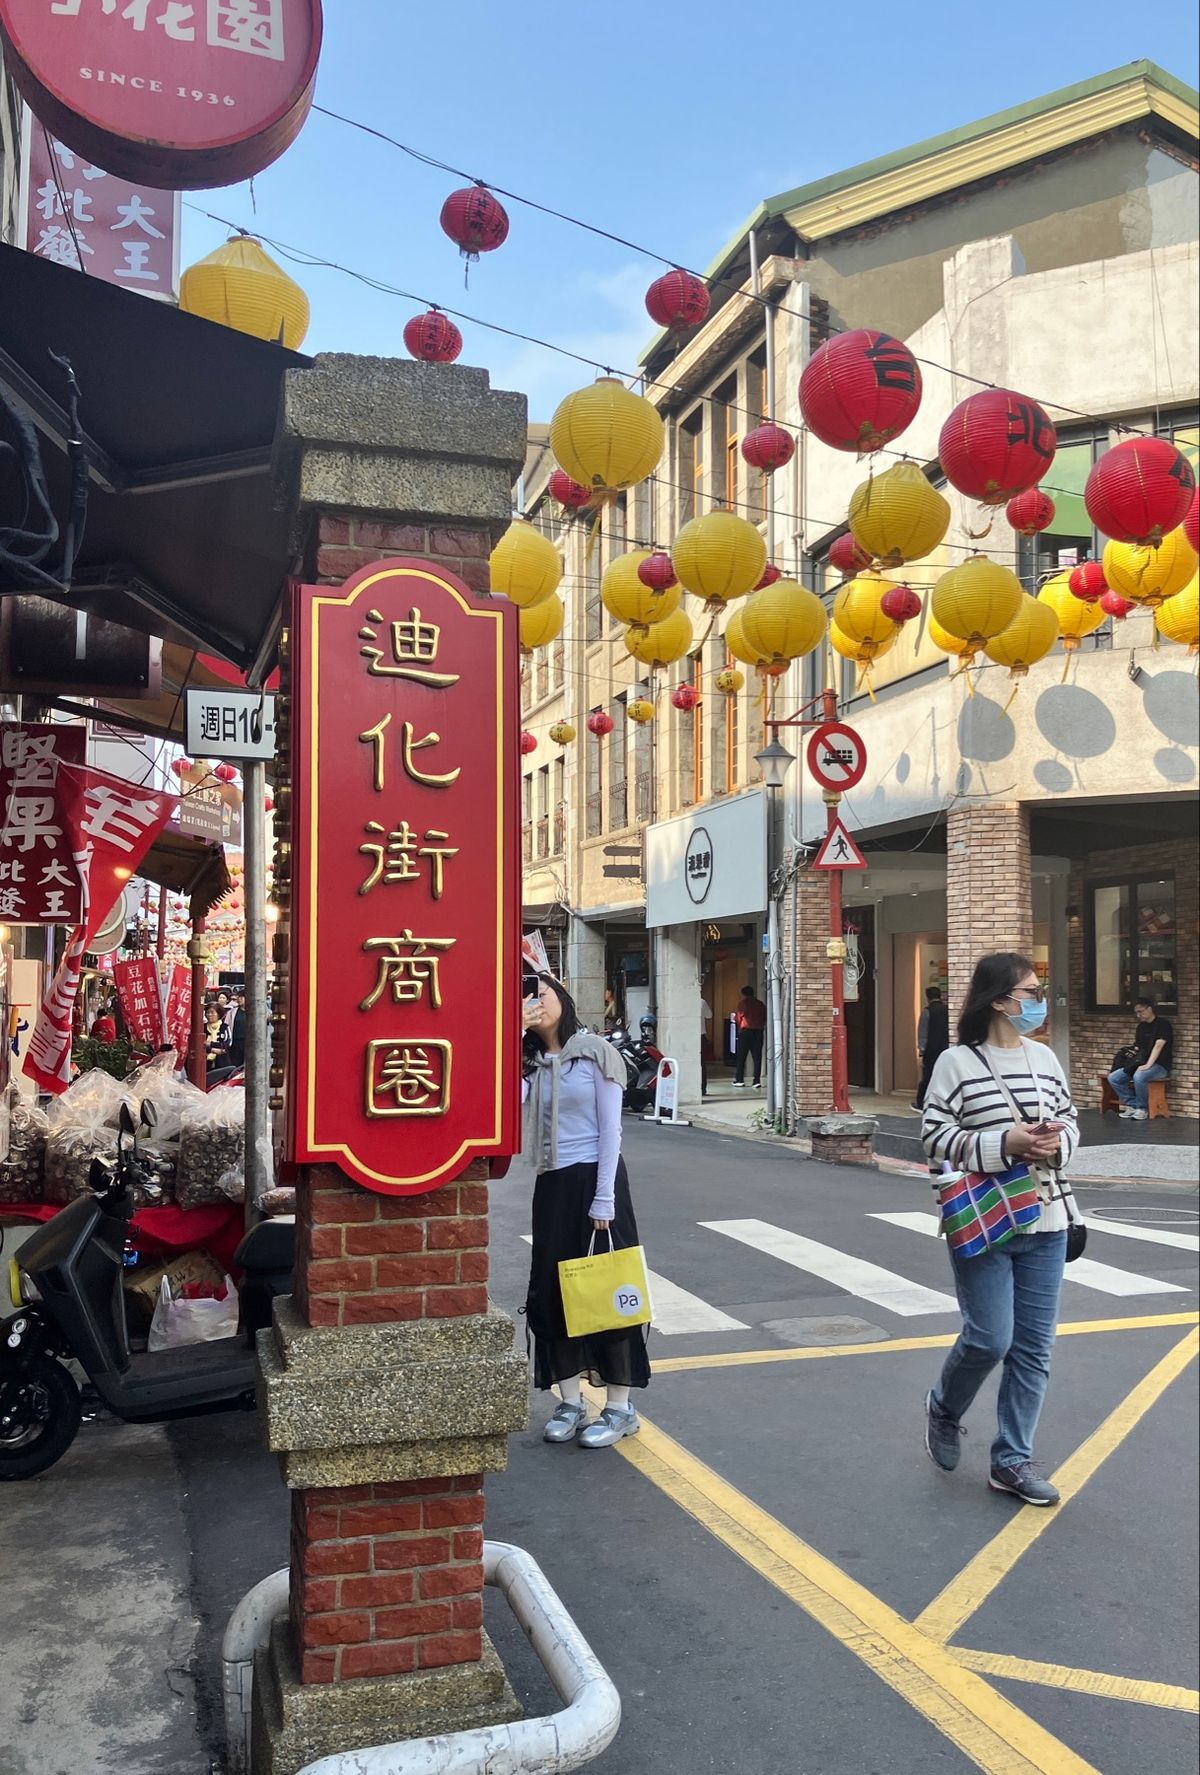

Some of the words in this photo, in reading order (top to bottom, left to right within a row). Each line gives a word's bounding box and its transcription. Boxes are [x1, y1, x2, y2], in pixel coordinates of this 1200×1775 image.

[79, 67, 163, 93] SINCE
[177, 86, 237, 107] 1936
[33, 179, 95, 271] 批發
[110, 195, 166, 280] 大王
[2, 730, 63, 853] 堅果
[37, 858, 76, 918] 大王
[358, 607, 462, 1119] 迪化街商圈
[127, 965, 154, 1041] 豆花加石花
